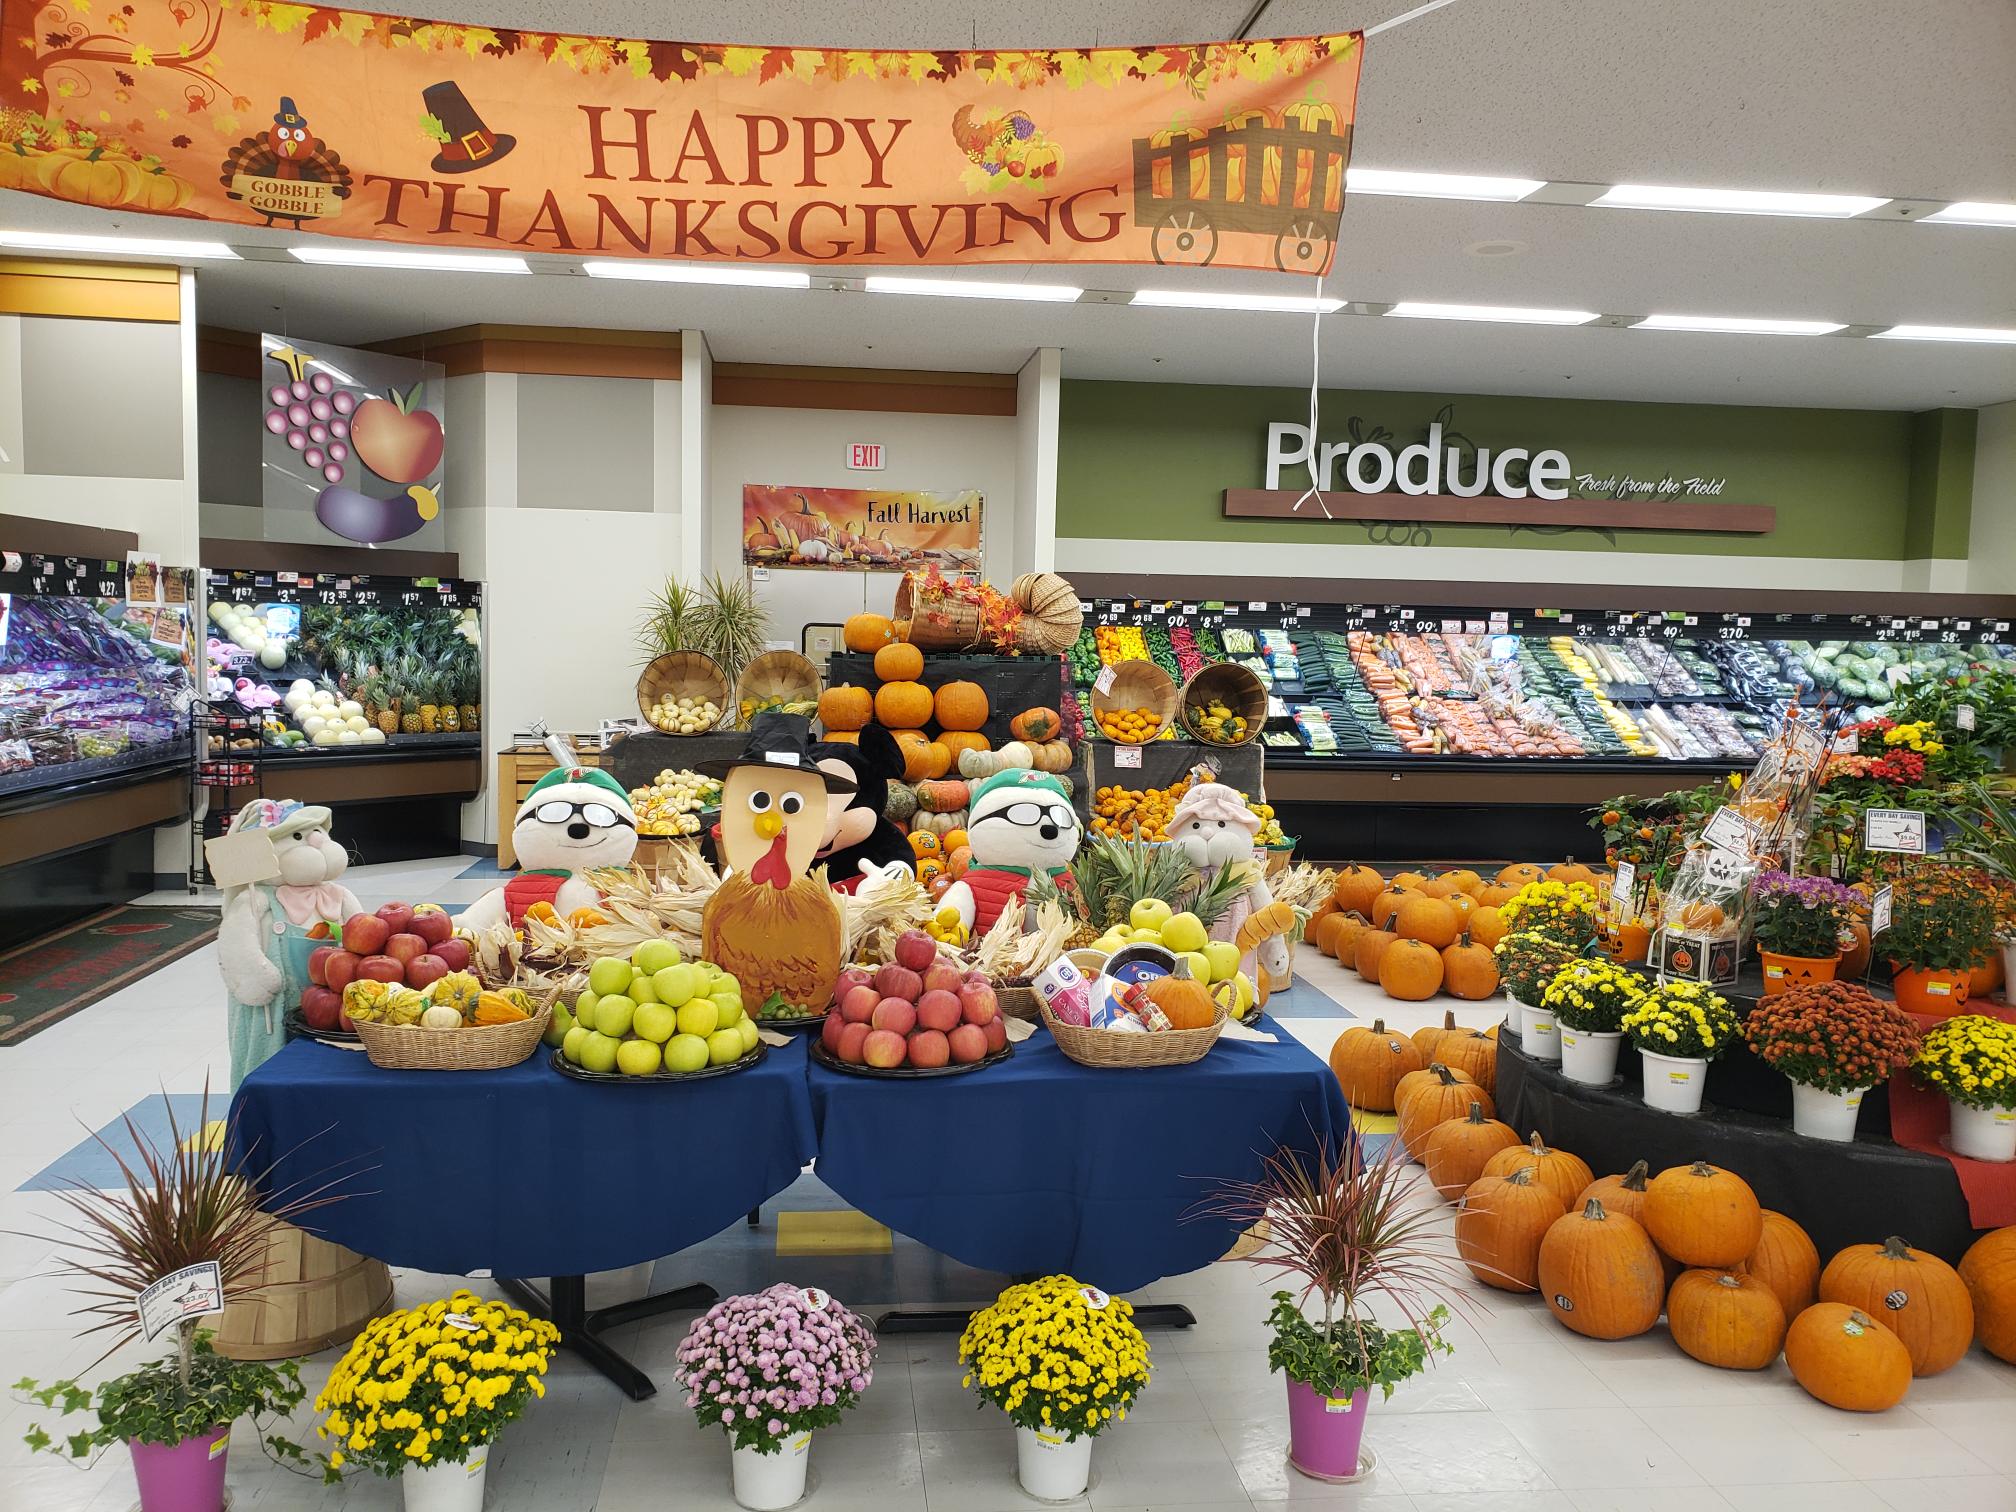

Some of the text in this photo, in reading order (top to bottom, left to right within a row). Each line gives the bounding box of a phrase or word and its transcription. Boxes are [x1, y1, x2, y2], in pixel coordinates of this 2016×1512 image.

[577, 104, 912, 188] HAPPY
[251, 180, 325, 199] GOBBLE
[249, 195, 324, 214] GOBBLE
[363, 173, 1127, 261] THANKSGIVING
[853, 445, 880, 467] EXIT
[1265, 422, 1571, 500] Produce
[1575, 473, 1726, 499] Fresh from the Field
[867, 501, 971, 524] Fall Harvest
